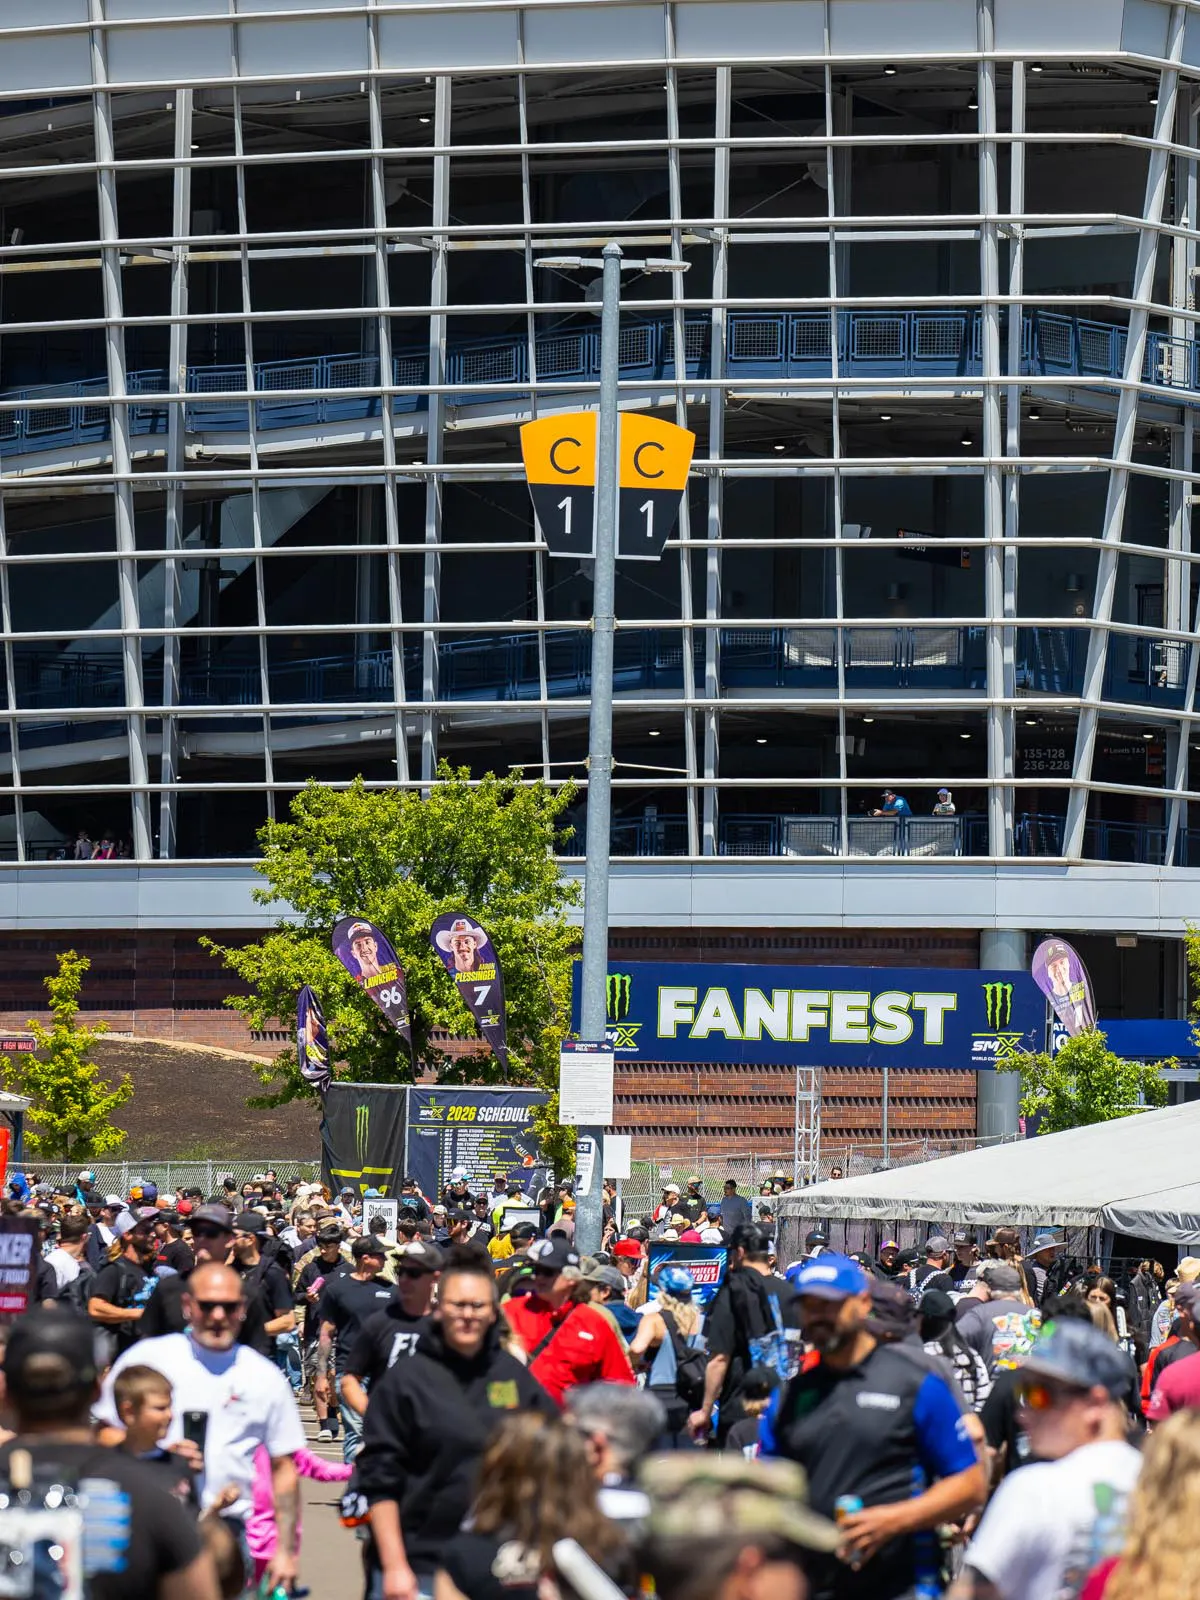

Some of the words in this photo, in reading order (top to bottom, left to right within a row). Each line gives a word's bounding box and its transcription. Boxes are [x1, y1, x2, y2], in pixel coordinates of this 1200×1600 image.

[549, 437, 582, 475] C
[633, 441, 665, 479] C
[557, 496, 572, 534] 1
[639, 499, 654, 538] 1
[1023, 748, 1066, 759] 135-128
[1023, 760, 1071, 771] 236-228
[363, 969, 399, 990] LAWRENCE
[454, 969, 497, 983] PLESSINGER
[379, 986, 402, 1009] 96
[473, 985, 492, 1006] 7
[656, 985, 958, 1046] FANFEST
[2, 1041, 17, 1050] HIGH
[17, 1041, 33, 1050] WALK
[605, 1027, 640, 1047] MX
[971, 1036, 1021, 1057] SMX
[446, 1105, 477, 1121] 2026
[368, 1204, 393, 1217] Stadium
